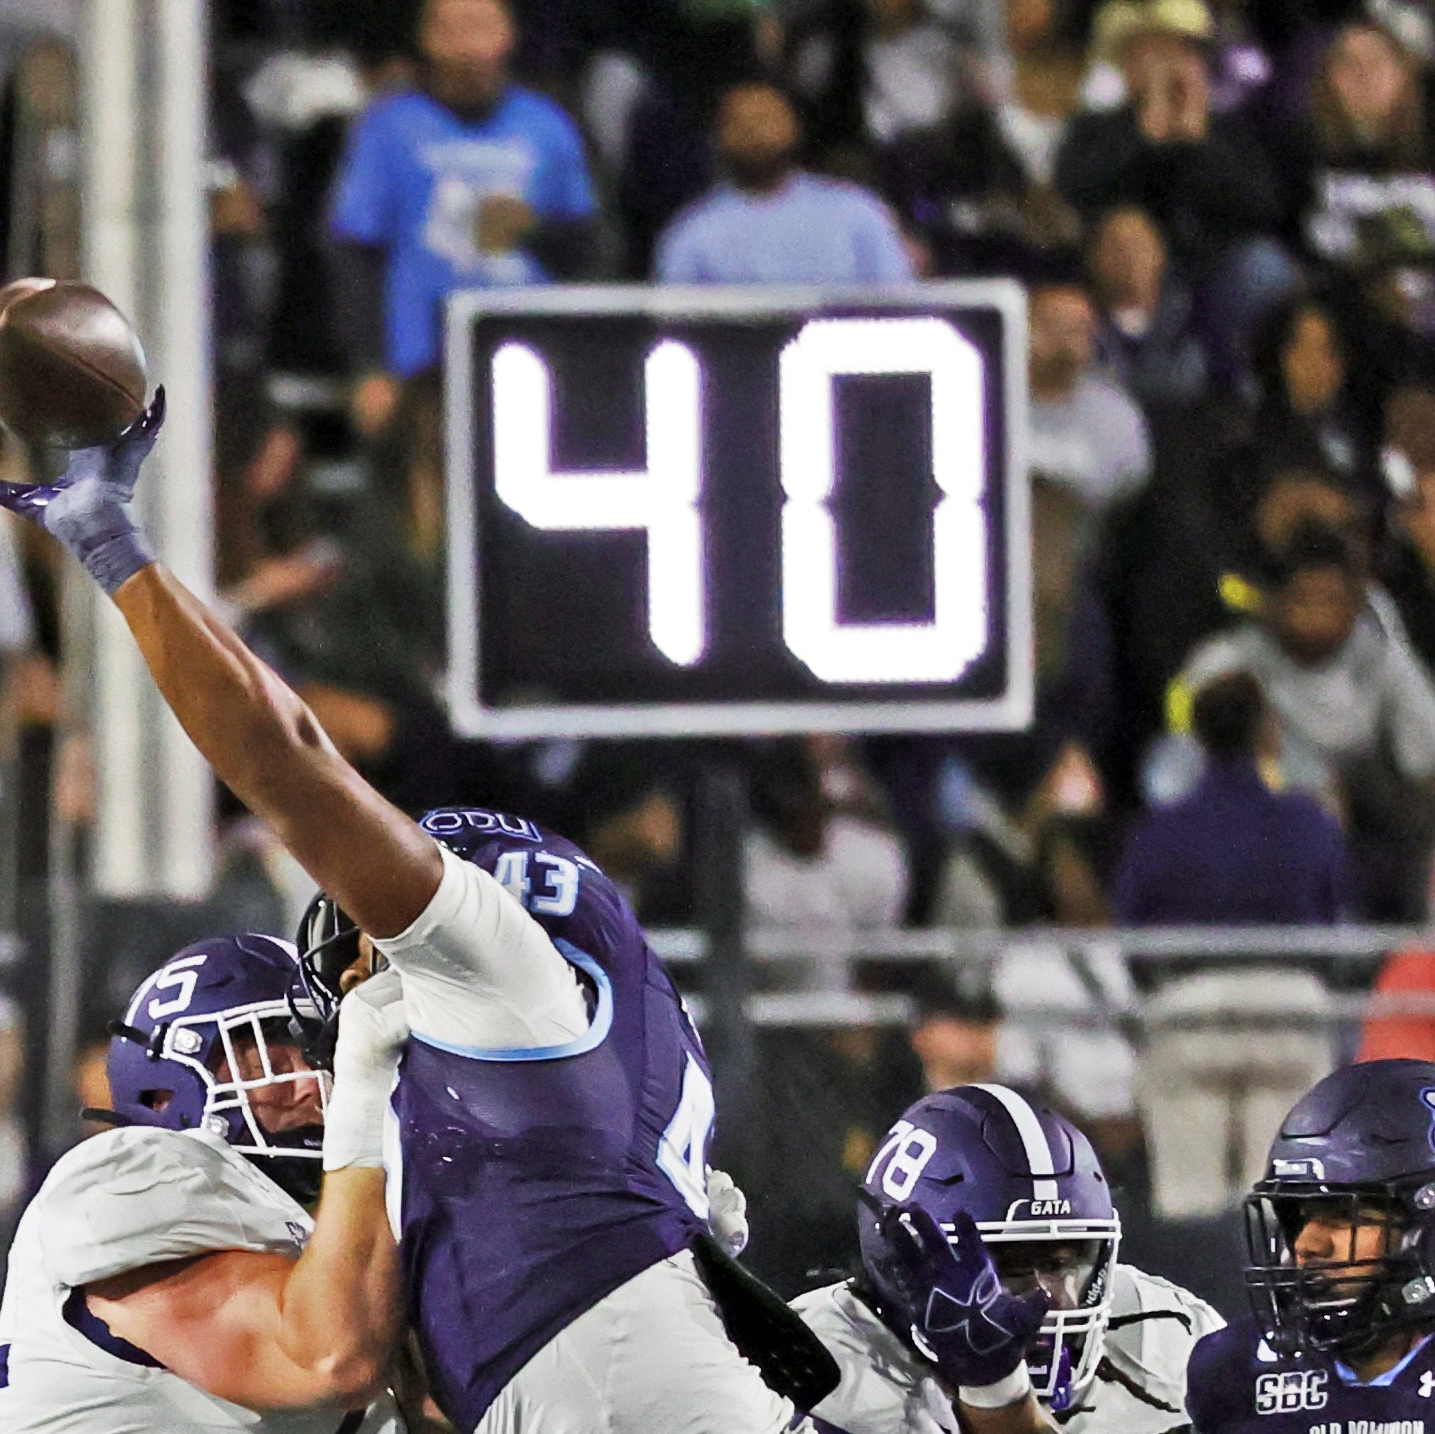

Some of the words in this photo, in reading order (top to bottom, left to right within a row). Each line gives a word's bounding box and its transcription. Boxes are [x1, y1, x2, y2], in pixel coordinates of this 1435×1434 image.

[490, 316, 988, 683] 40
[421, 810, 539, 840] ODU
[493, 850, 579, 917] 43
[866, 1120, 937, 1202] 78
[1030, 1199, 1071, 1216] GATA
[1255, 1369, 1329, 1415] SBC
